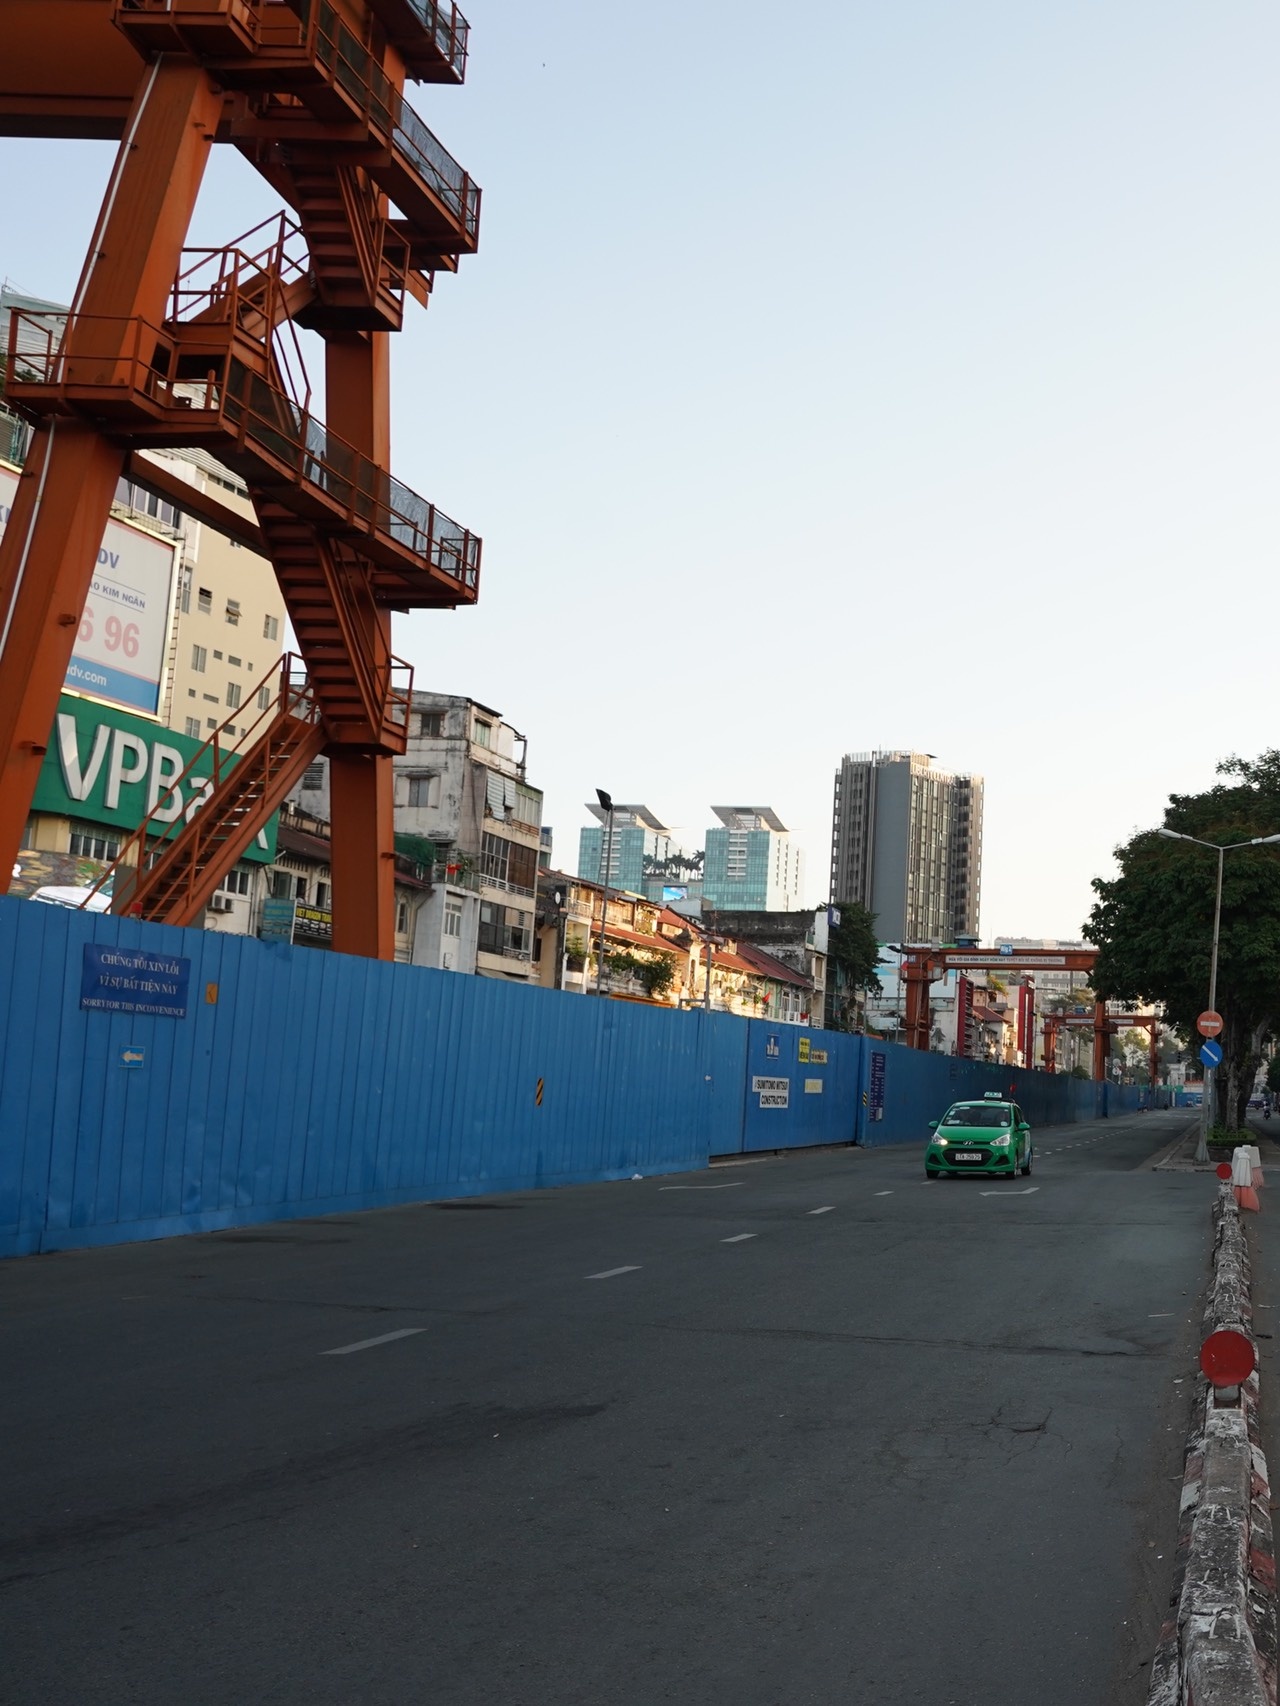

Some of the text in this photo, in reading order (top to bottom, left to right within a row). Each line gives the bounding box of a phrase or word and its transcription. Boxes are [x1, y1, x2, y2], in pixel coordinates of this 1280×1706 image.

[102, 585, 120, 599] KIM
[104, 615, 140, 658] 96
[100, 952, 179, 975] CHÚNG TÔI XIN LỖI
[99, 972, 110, 986] VÌ
[123, 975, 138, 989] BẤT
[140, 979, 160, 994] TIỆN
[82, 997, 105, 1007] SORRY
[761, 1095, 787, 1105] CONSTRUCTION
